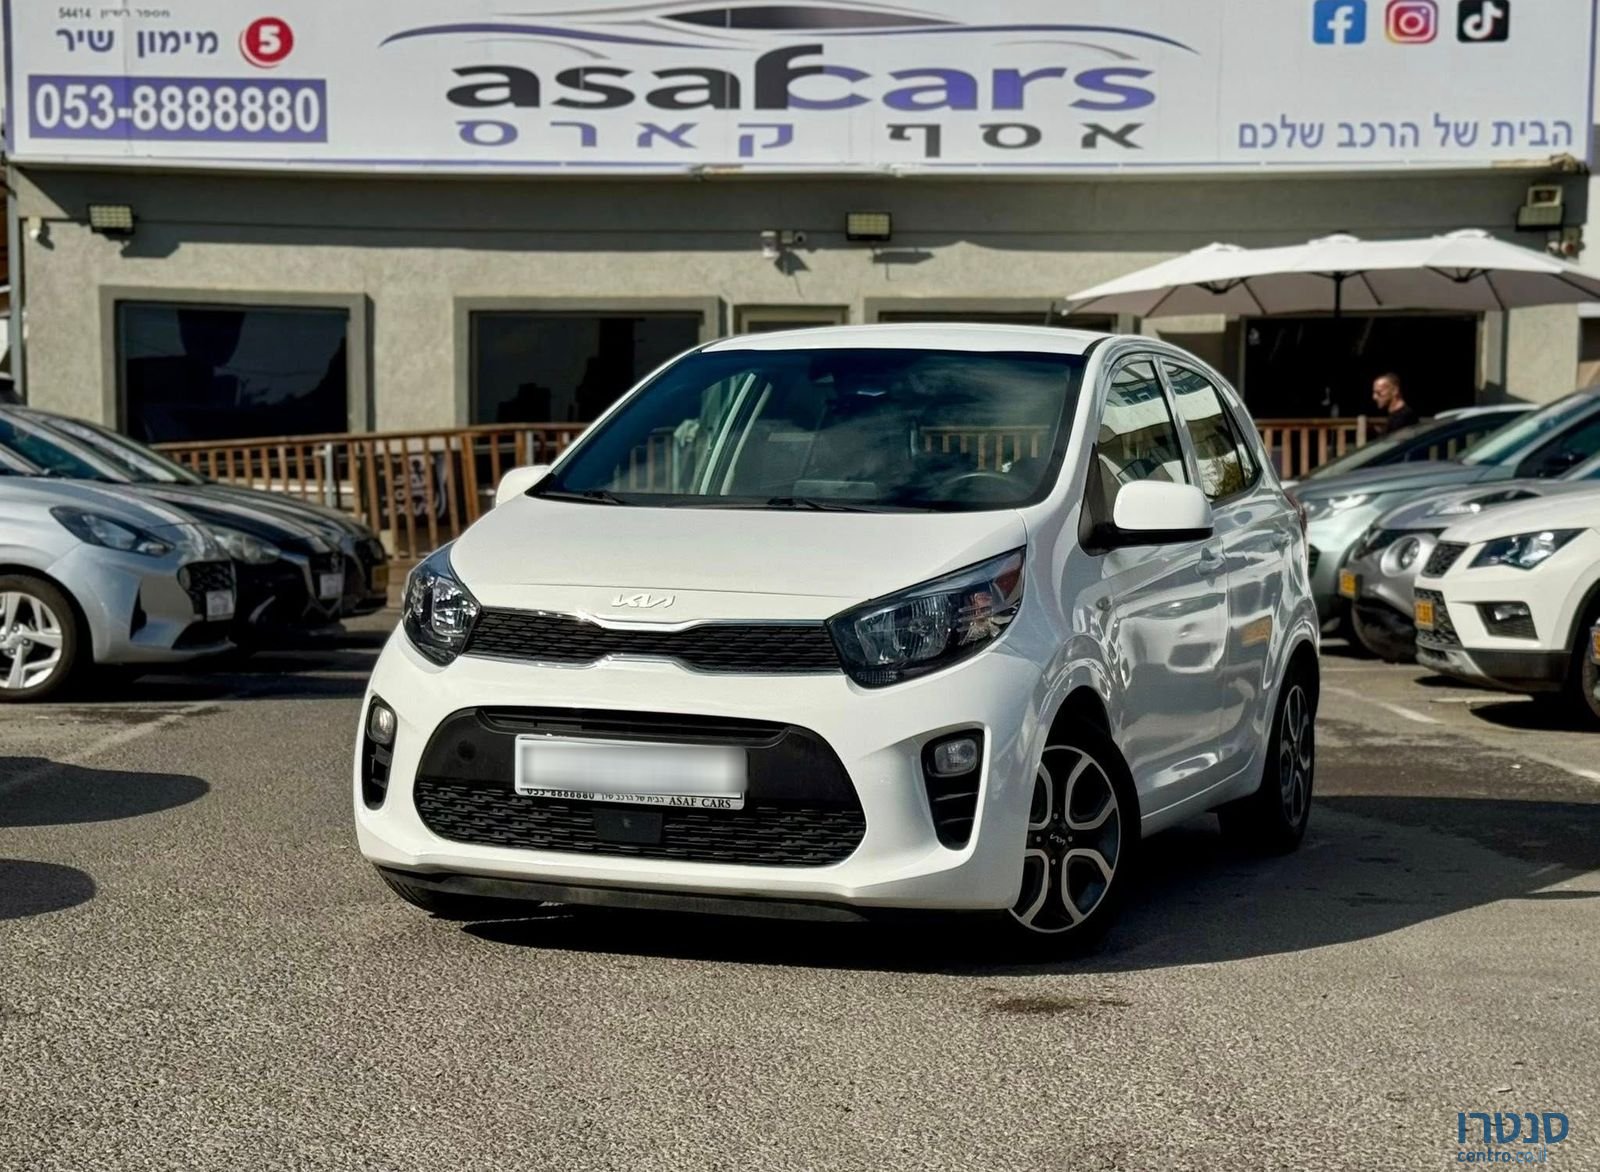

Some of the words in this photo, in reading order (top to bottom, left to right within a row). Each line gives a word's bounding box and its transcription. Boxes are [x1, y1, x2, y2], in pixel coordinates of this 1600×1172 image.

[58, 7, 92, 19] 54414
[56, 28, 115, 53] שיר
[137, 29, 219, 59] מימון
[35, 83, 320, 133] 053-8888880
[455, 120, 794, 158] קארס
[886, 122, 1144, 158] אסף
[1238, 113, 1325, 149] שלכם
[1337, 121, 1420, 149] הרכב
[1433, 112, 1479, 148] של
[1491, 120, 1574, 148] הבית
[669, 797, 697, 806] ASAF
[701, 799, 732, 809] CARS
